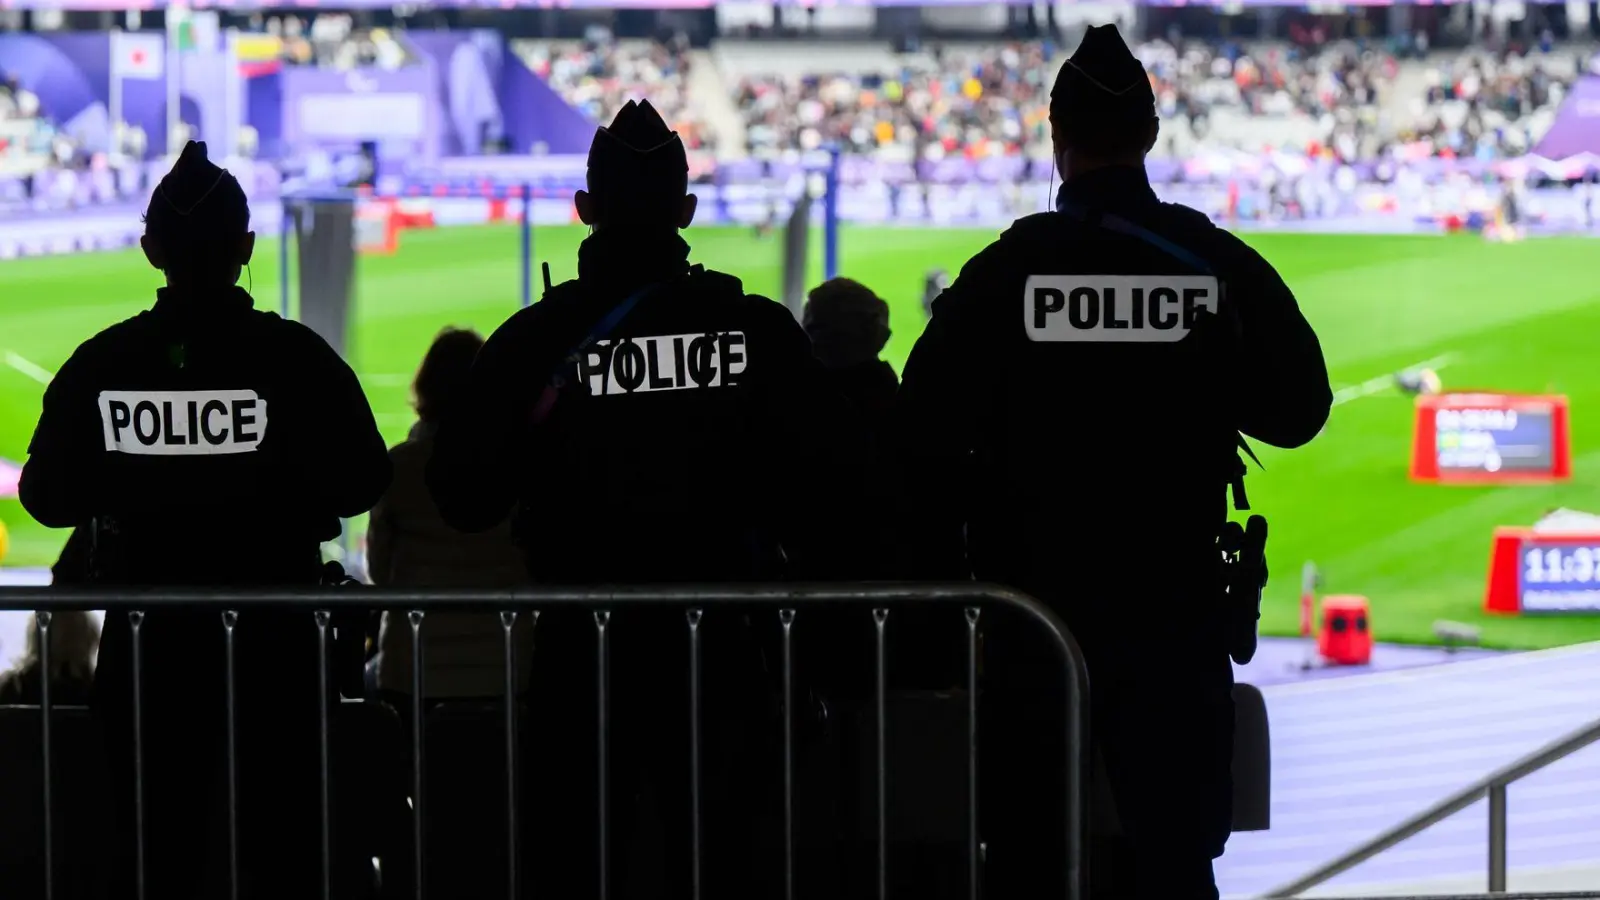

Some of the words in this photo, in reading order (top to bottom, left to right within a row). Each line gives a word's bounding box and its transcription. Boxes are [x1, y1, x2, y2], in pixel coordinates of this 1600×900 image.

[1033, 286, 1209, 330] POLICE
[580, 332, 745, 394] POLICE
[108, 399, 259, 446] POLICE
